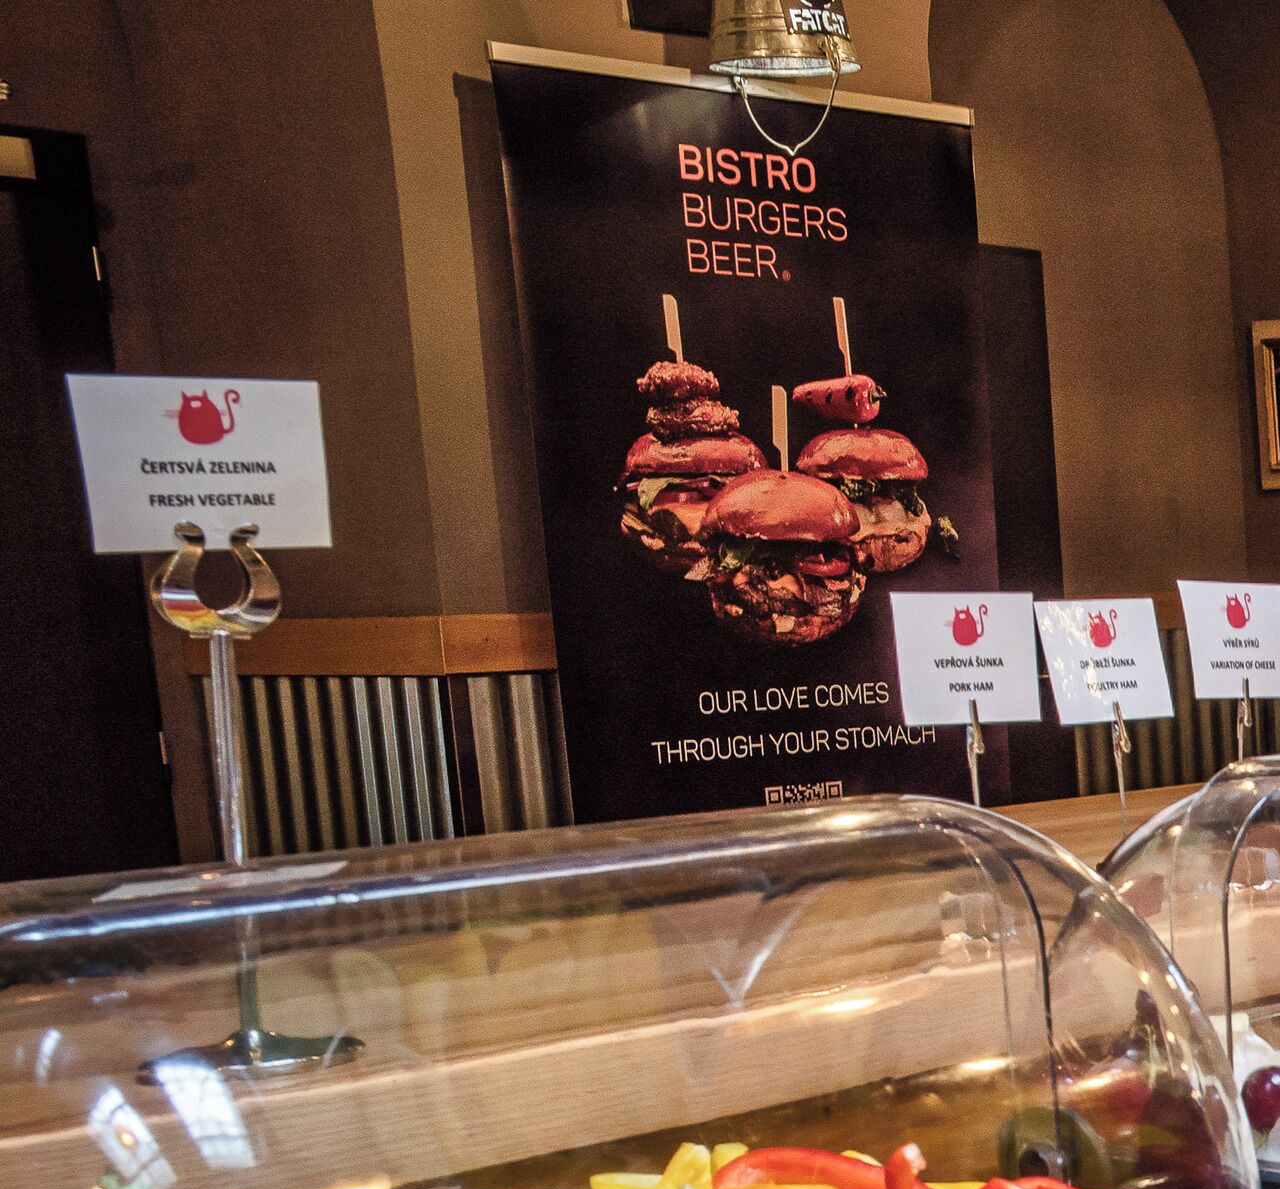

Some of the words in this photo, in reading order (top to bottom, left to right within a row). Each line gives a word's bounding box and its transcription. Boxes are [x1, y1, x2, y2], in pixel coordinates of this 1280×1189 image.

[678, 142, 818, 194] BISTRO
[681, 192, 849, 243] BURGERS
[140, 457, 206, 475] ČERTSVÁ
[208, 460, 277, 475] ZELENINA
[149, 493, 195, 508] FRESH
[199, 492, 277, 507] VEGETABLE
[1223, 637, 1243, 648] VÝBĚR
[934, 656, 974, 669] VEPŘOVÁ
[975, 655, 1004, 668] ŠUNKA
[1080, 657, 1111, 670] DRBEŽÍ
[1111, 656, 1136, 669] ŠUNKA
[1210, 660, 1245, 670] VARIATION
[1245, 660, 1254, 670] OF
[1254, 661, 1276, 670] CHEESE
[949, 682, 972, 693] PORK
[973, 681, 994, 692] HAM
[1120, 679, 1138, 690] HAM
[697, 689, 749, 716] OUR
[753, 684, 809, 713] LOVE
[814, 681, 890, 710] COMES
[651, 734, 765, 765] THROUGH
[770, 728, 830, 757] YOUR
[834, 723, 937, 751] STOMACH
